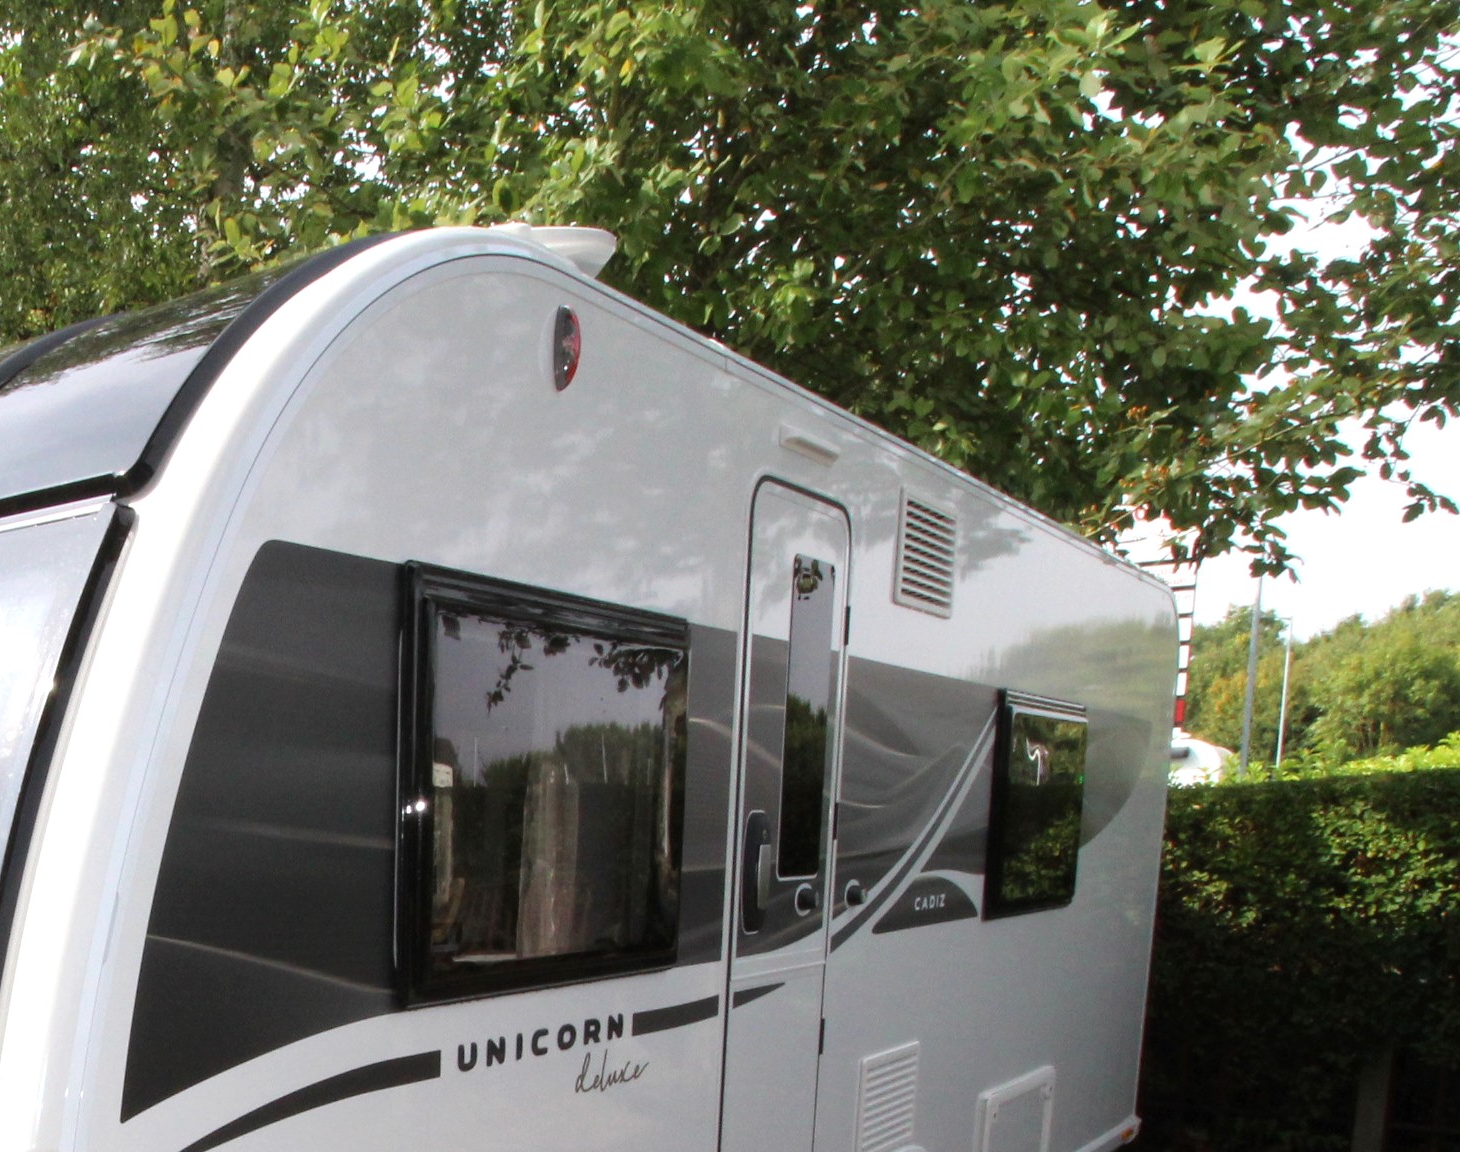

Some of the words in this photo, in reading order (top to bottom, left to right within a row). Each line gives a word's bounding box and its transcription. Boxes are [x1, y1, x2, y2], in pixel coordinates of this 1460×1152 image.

[914, 893, 946, 911] CADIZ
[457, 1013, 624, 1072] UNICORN
[575, 1049, 650, 1092] deluxe
